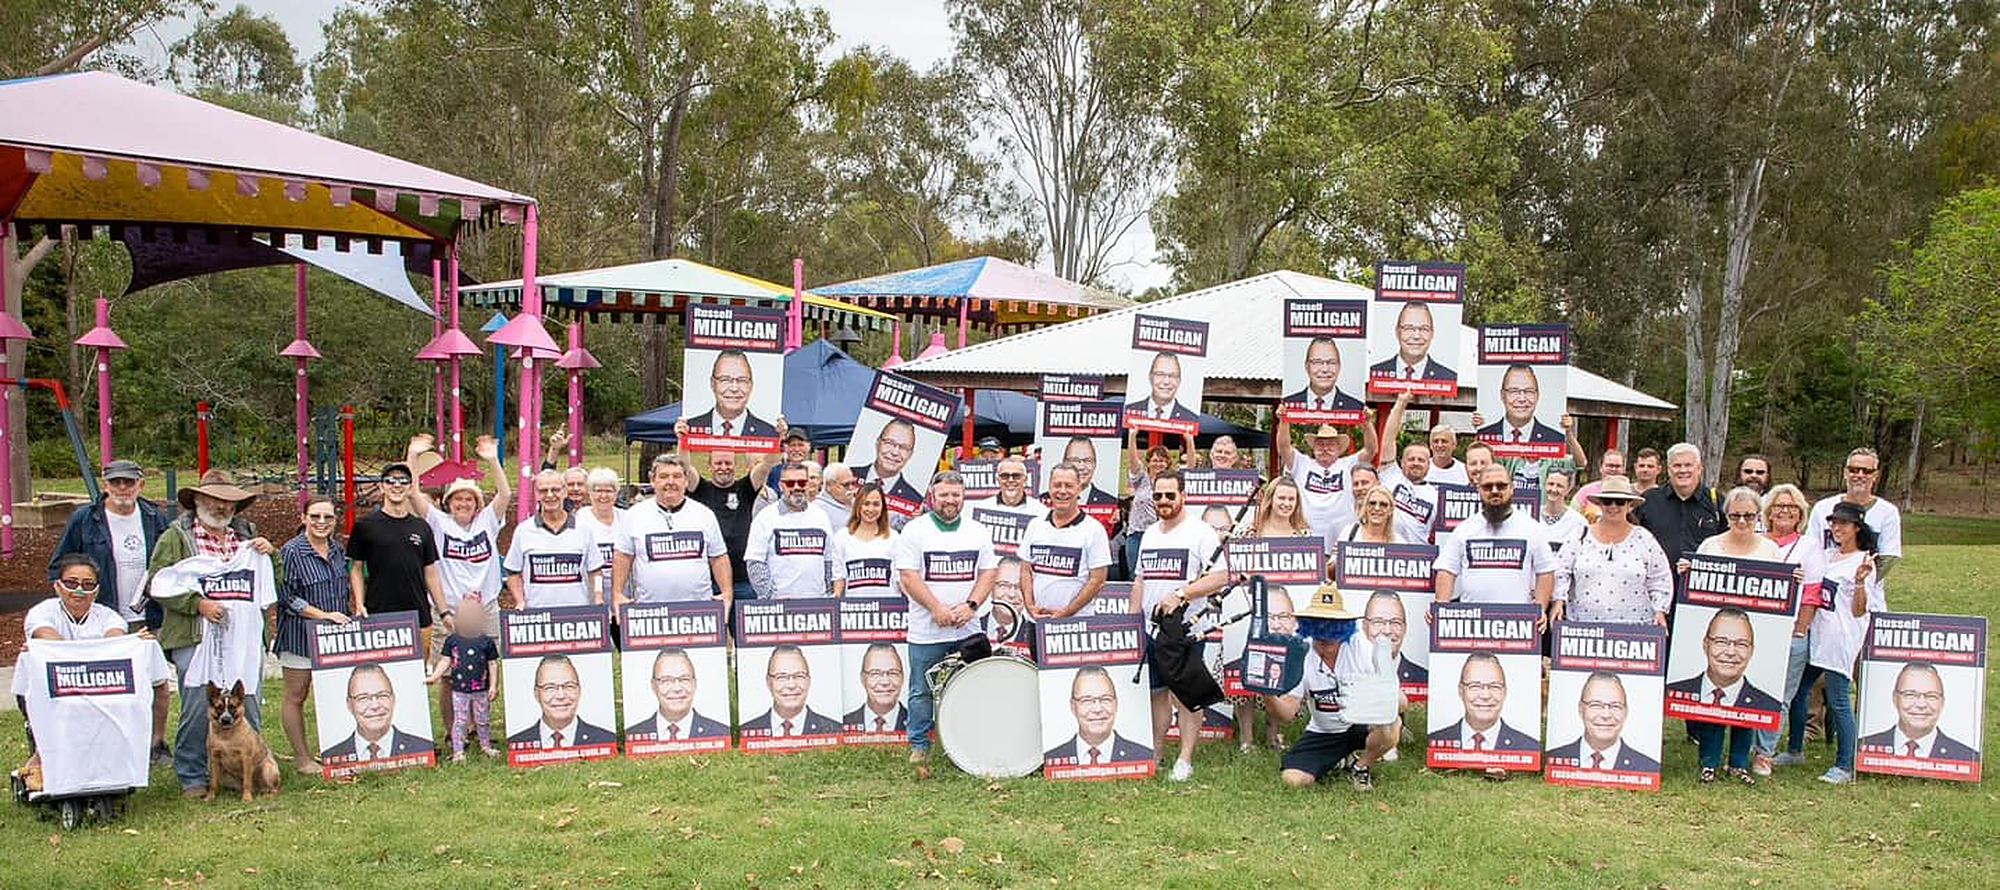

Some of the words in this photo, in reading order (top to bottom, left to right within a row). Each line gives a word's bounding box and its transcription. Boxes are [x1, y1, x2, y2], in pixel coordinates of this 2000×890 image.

[1382, 265, 1418, 274] Russell
[1382, 274, 1458, 291] MILLIGAN
[694, 308, 733, 320] Russell
[1290, 303, 1323, 311] Russell
[1290, 311, 1361, 327] MILLIGAN
[693, 318, 778, 340] MILLIGAN
[1139, 327, 1203, 346] MILLIGAN
[1485, 328, 1520, 336] Russell
[1485, 336, 1561, 353] MILLIGAN
[881, 374, 915, 394] Russell
[1043, 382, 1100, 398] MILLIGAN
[875, 383, 950, 421] MILLIGAN
[1049, 412, 1118, 428] MILLIGAN
[960, 464, 993, 472] Russell
[1184, 471, 1216, 480] Russell
[1184, 480, 1253, 495] MILLIGAN
[980, 512, 1017, 527] Russell
[652, 539, 701, 554] MILLIGAN
[1229, 543, 1269, 554] Russell
[1346, 546, 1385, 557] Russell
[1470, 547, 1521, 561] MILLIGAN
[1229, 552, 1317, 572] MILLIGAN
[1345, 555, 1431, 578] MILLIGAN
[1691, 560, 1736, 573] Russell
[1688, 571, 1790, 600] MILLIGAN
[628, 607, 668, 620] Russell
[744, 604, 784, 615] Russell
[840, 601, 880, 612] Russell
[1438, 607, 1481, 619] Russell
[508, 612, 551, 625] Russell
[744, 613, 832, 634] MILLIGAN
[840, 611, 909, 630] MILLIGA
[1875, 618, 1920, 630] Russell
[509, 621, 602, 645] MILLIGAN
[628, 616, 718, 638] MILLIGAN
[1045, 621, 1087, 634] Russell
[1438, 618, 1534, 640] MILLIGAN
[1561, 626, 1605, 638] Russell
[318, 627, 414, 655] MILLIGAN
[1046, 630, 1139, 654] MILLIGAN
[1560, 637, 1657, 660] MILLIGAN
[1874, 629, 1976, 652] MILLIGAN
[56, 670, 126, 688] MILLIGAN
